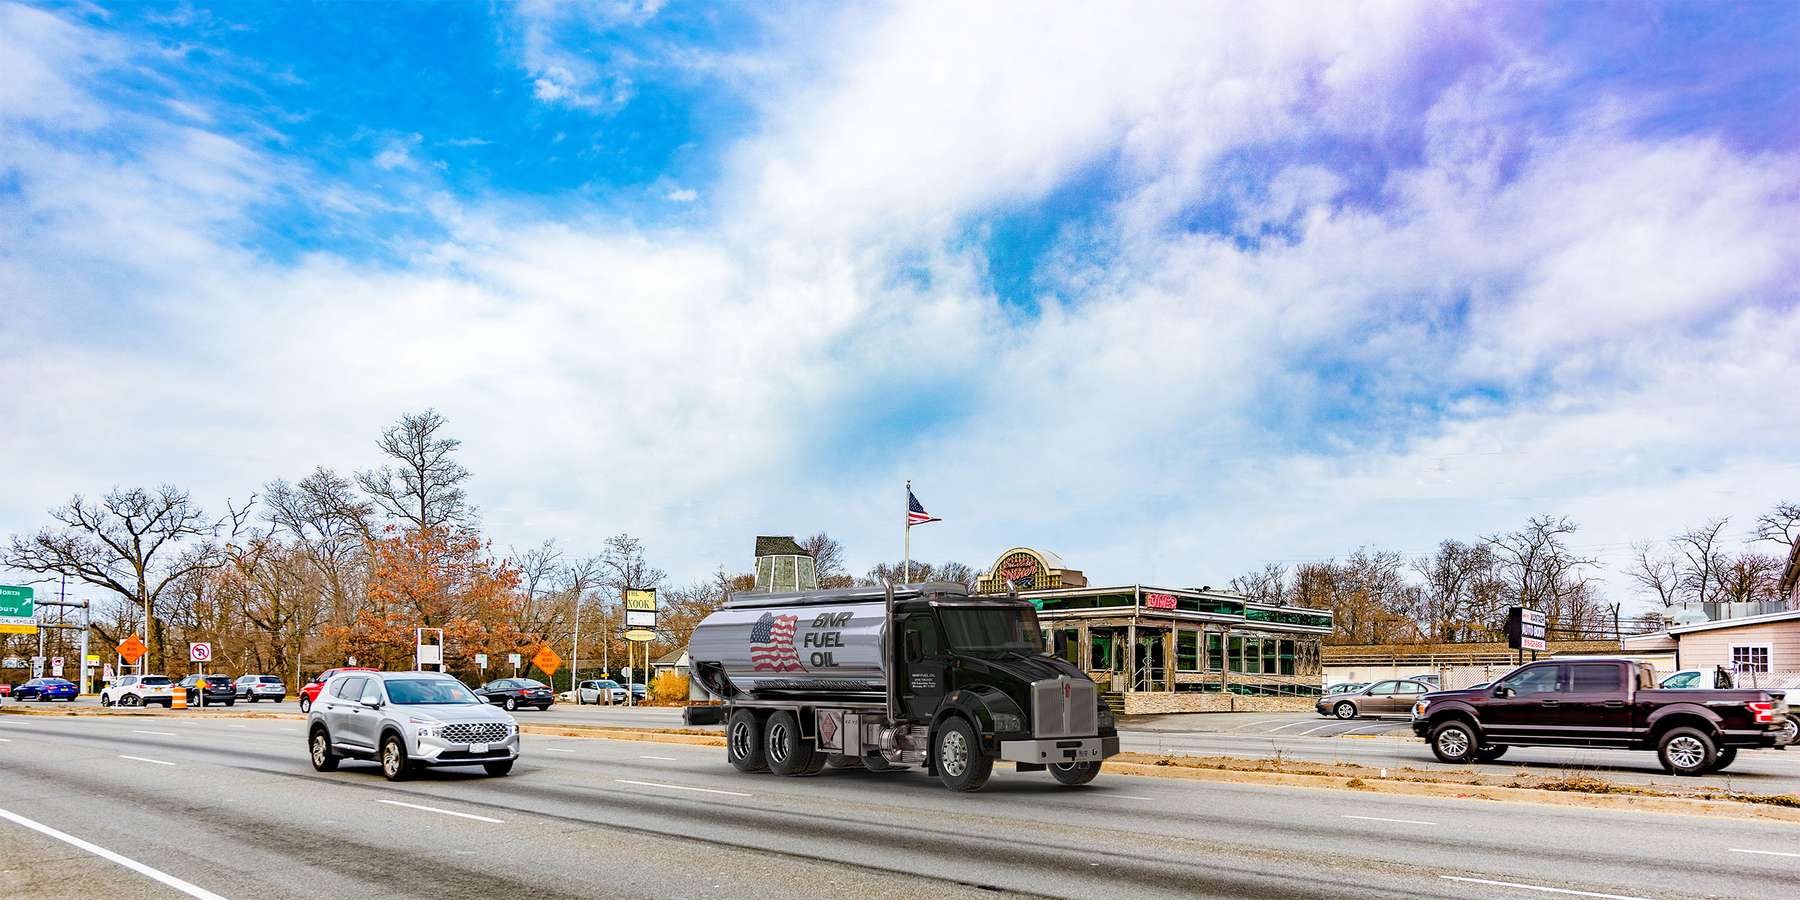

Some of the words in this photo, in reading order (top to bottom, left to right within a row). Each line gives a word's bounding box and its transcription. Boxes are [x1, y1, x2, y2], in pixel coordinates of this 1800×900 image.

[812, 611, 854, 627] BNR
[804, 632, 844, 648] FUEL
[810, 652, 839, 667] OIL
